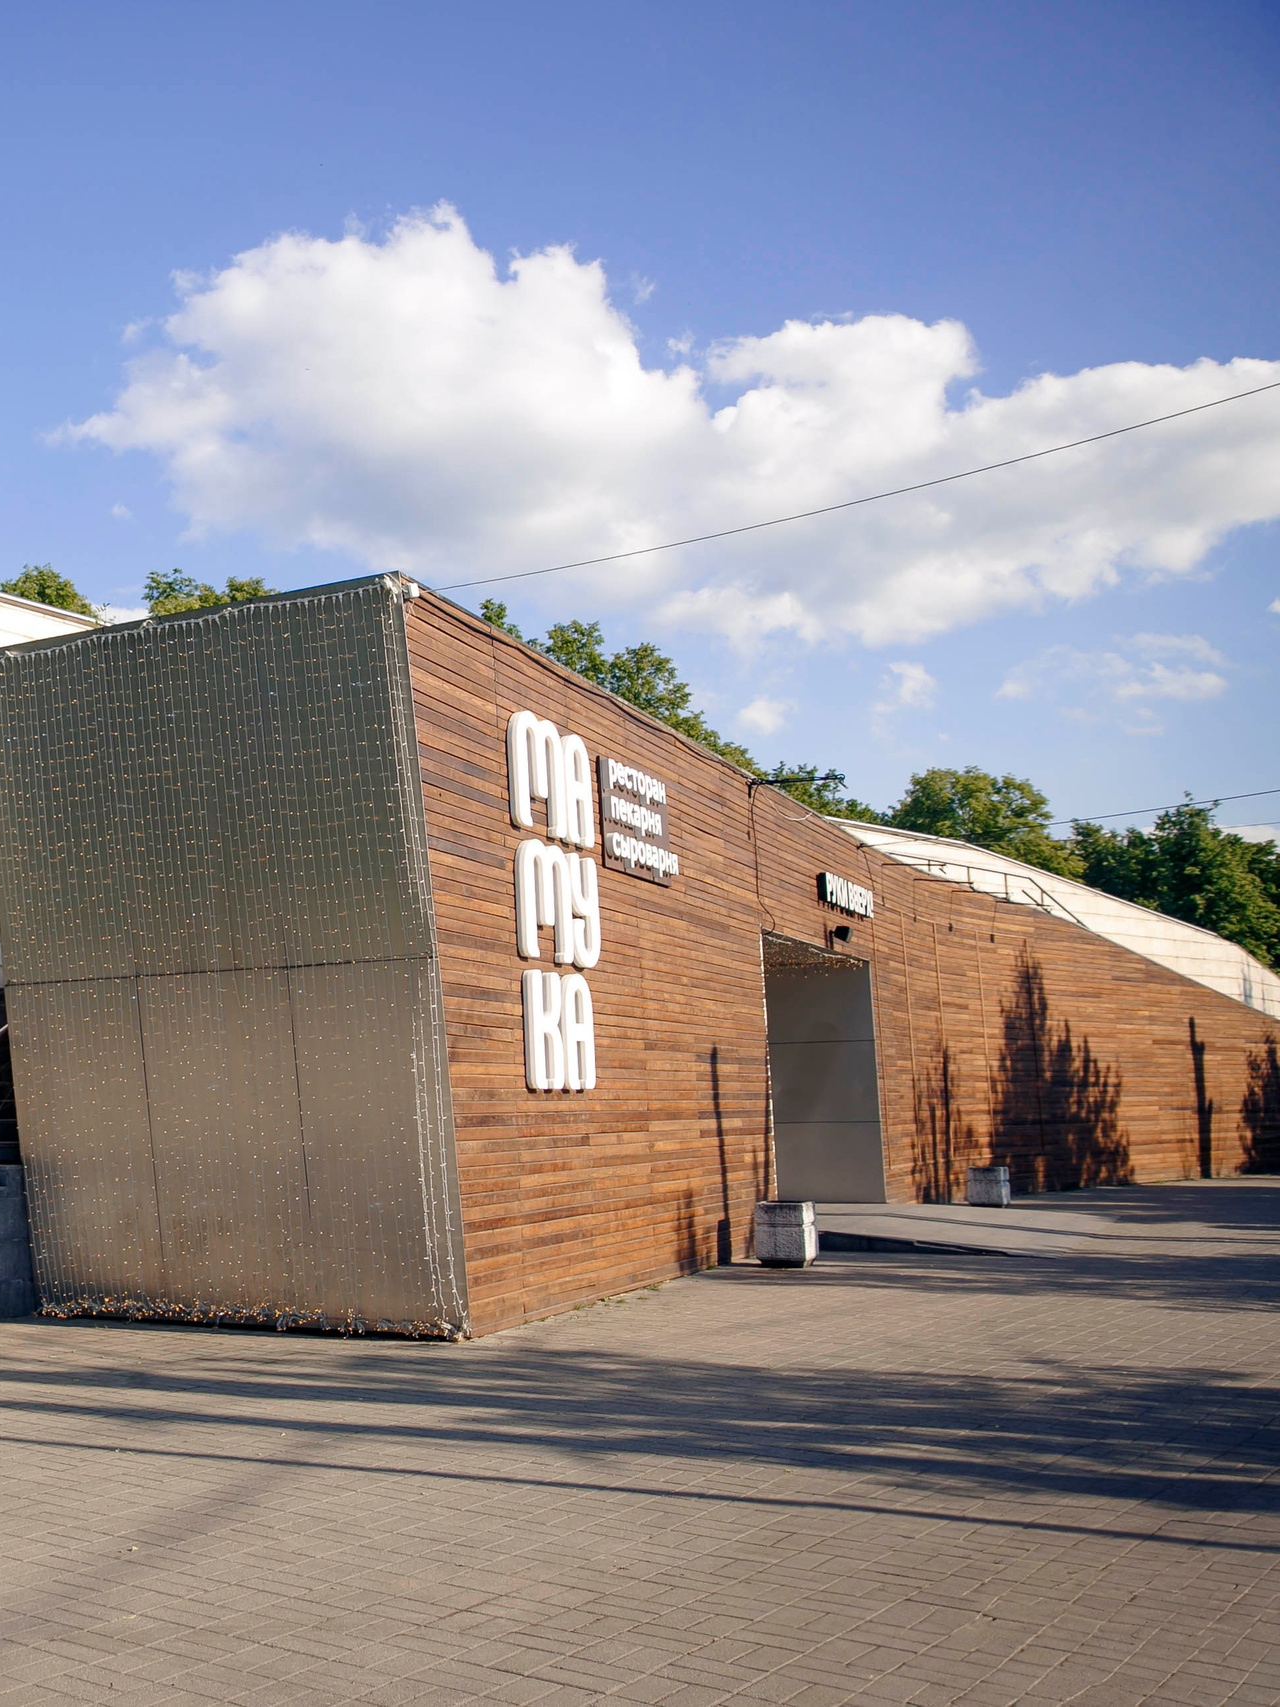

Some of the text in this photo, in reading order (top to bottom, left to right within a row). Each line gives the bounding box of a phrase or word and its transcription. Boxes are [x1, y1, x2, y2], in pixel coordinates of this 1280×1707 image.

[506, 710, 595, 849] МА
[608, 758, 667, 805] ресторан
[610, 795, 663, 837] пекарня
[612, 832, 679, 877] сыроварня
[515, 839, 601, 969] МУ
[825, 871, 849, 909] РУКИ
[522, 969, 597, 1091] КА
